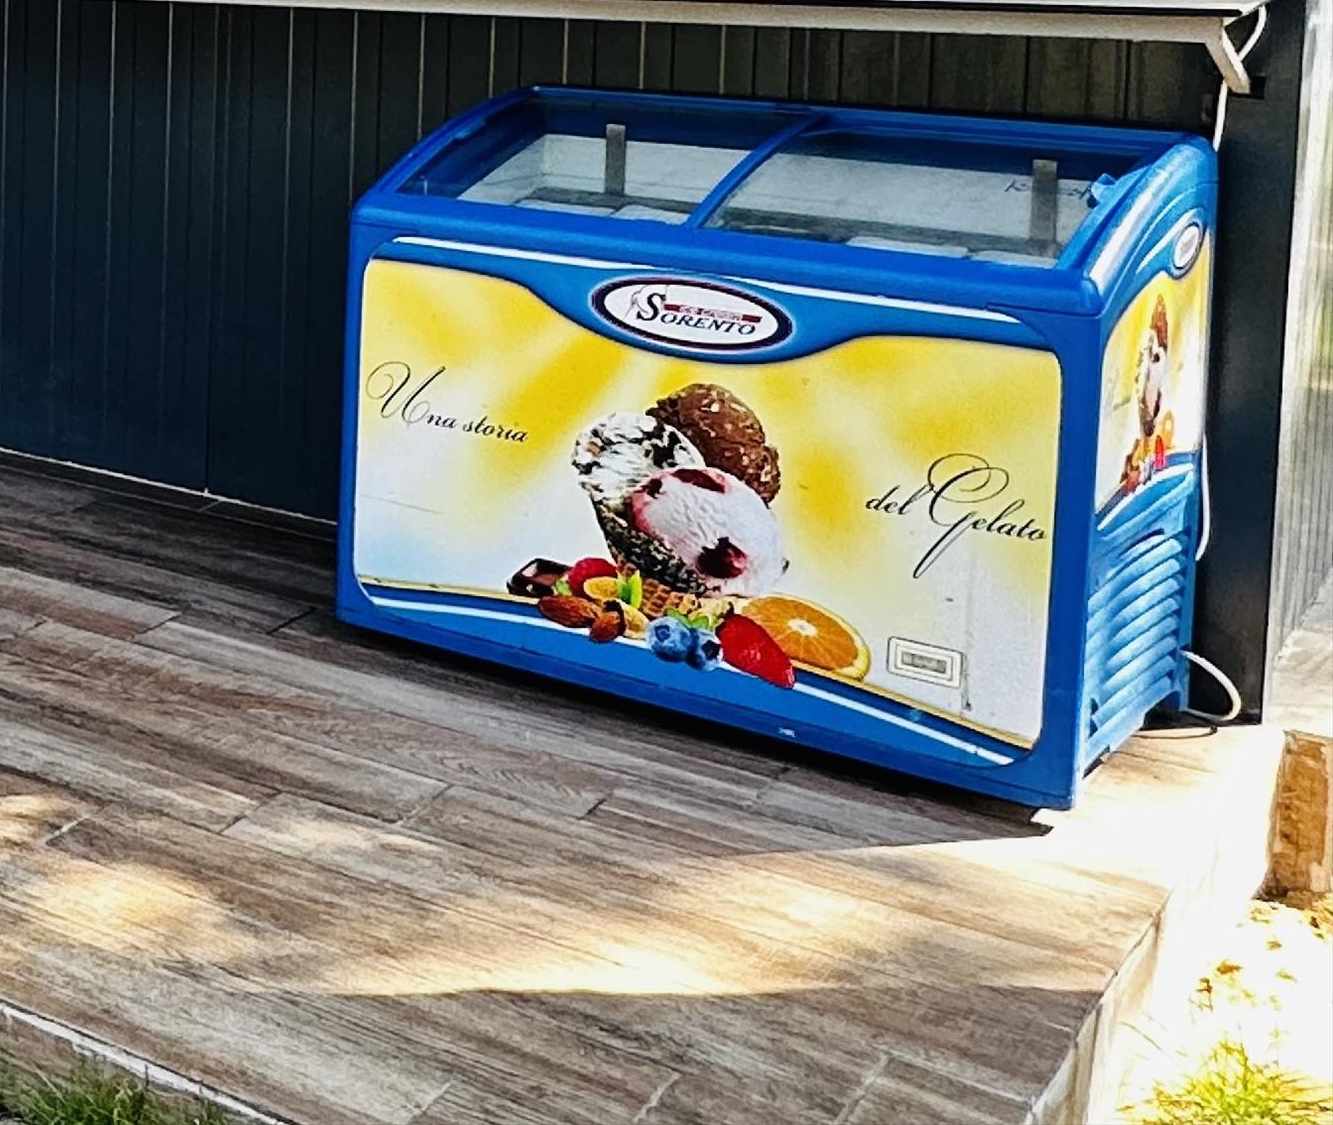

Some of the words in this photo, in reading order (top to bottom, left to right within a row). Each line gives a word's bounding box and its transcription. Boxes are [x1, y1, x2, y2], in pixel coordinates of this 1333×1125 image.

[637, 293, 756, 335] SORENTO
[366, 361, 457, 429] Una
[463, 416, 528, 443] storia
[865, 484, 933, 515] del
[913, 453, 1047, 579] Gelato
